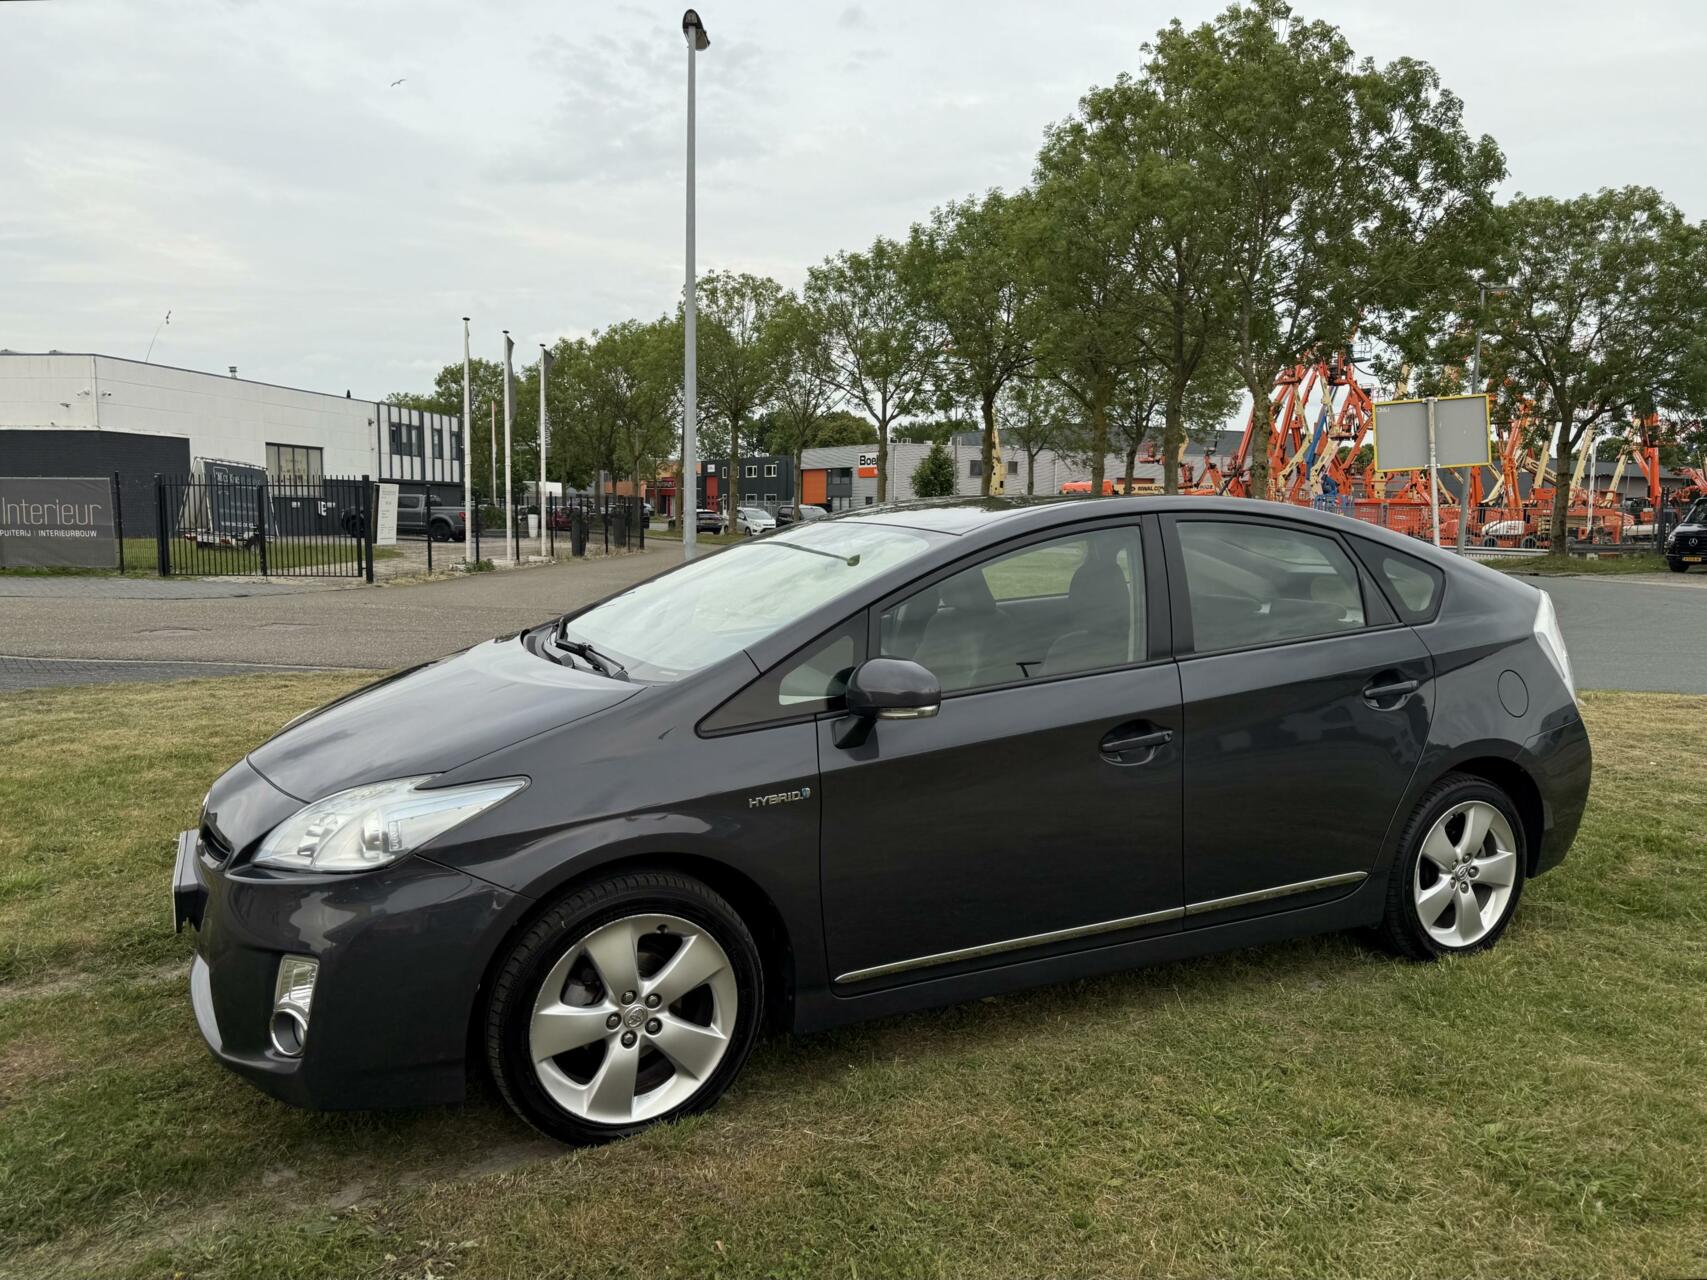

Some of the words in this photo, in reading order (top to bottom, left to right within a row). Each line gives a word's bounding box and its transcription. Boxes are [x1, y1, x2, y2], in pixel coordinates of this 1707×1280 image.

[2, 496, 102, 526] Interieur
[0, 529, 31, 537] PUITERIJ
[38, 529, 97, 538] INTERIEURBOUW
[748, 790, 801, 809] HYBRID
